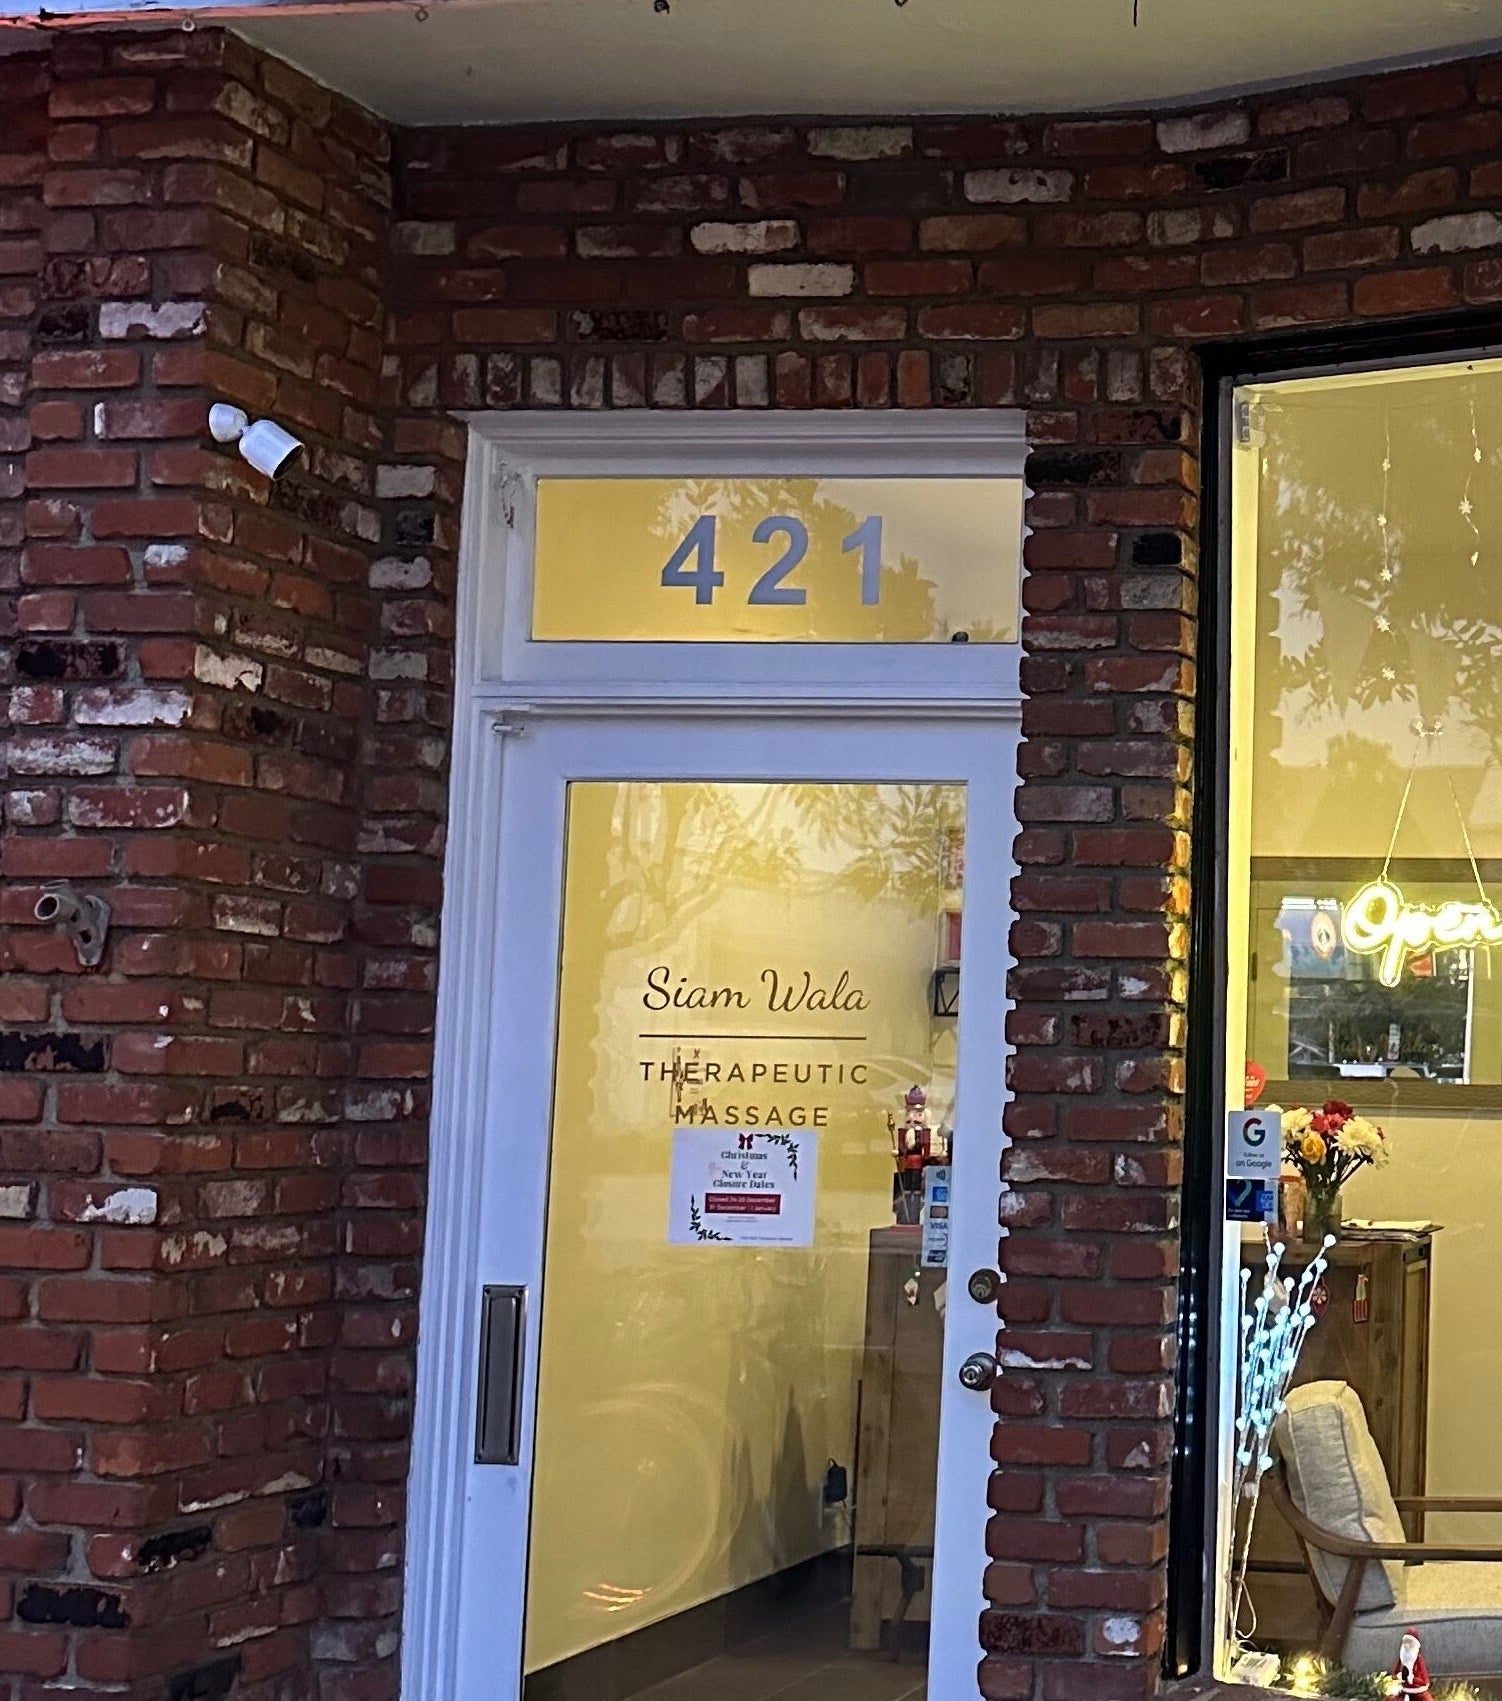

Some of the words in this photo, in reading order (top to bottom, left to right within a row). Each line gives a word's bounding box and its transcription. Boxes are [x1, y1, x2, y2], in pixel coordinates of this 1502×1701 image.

[660, 515, 883, 605] 421
[643, 966, 751, 1010] Siam
[761, 968, 871, 1012] Wala
[639, 1061, 868, 1084] THERAPEUTIC
[674, 1105, 829, 1126] MASSAGE
[720, 1150, 768, 1160] Christmas
[1246, 1158, 1272, 1169] Google
[722, 1170, 743, 1179] New
[745, 1170, 767, 1179] Year
[712, 1179, 748, 1188] Closure
[749, 1179, 775, 1189] Dates
